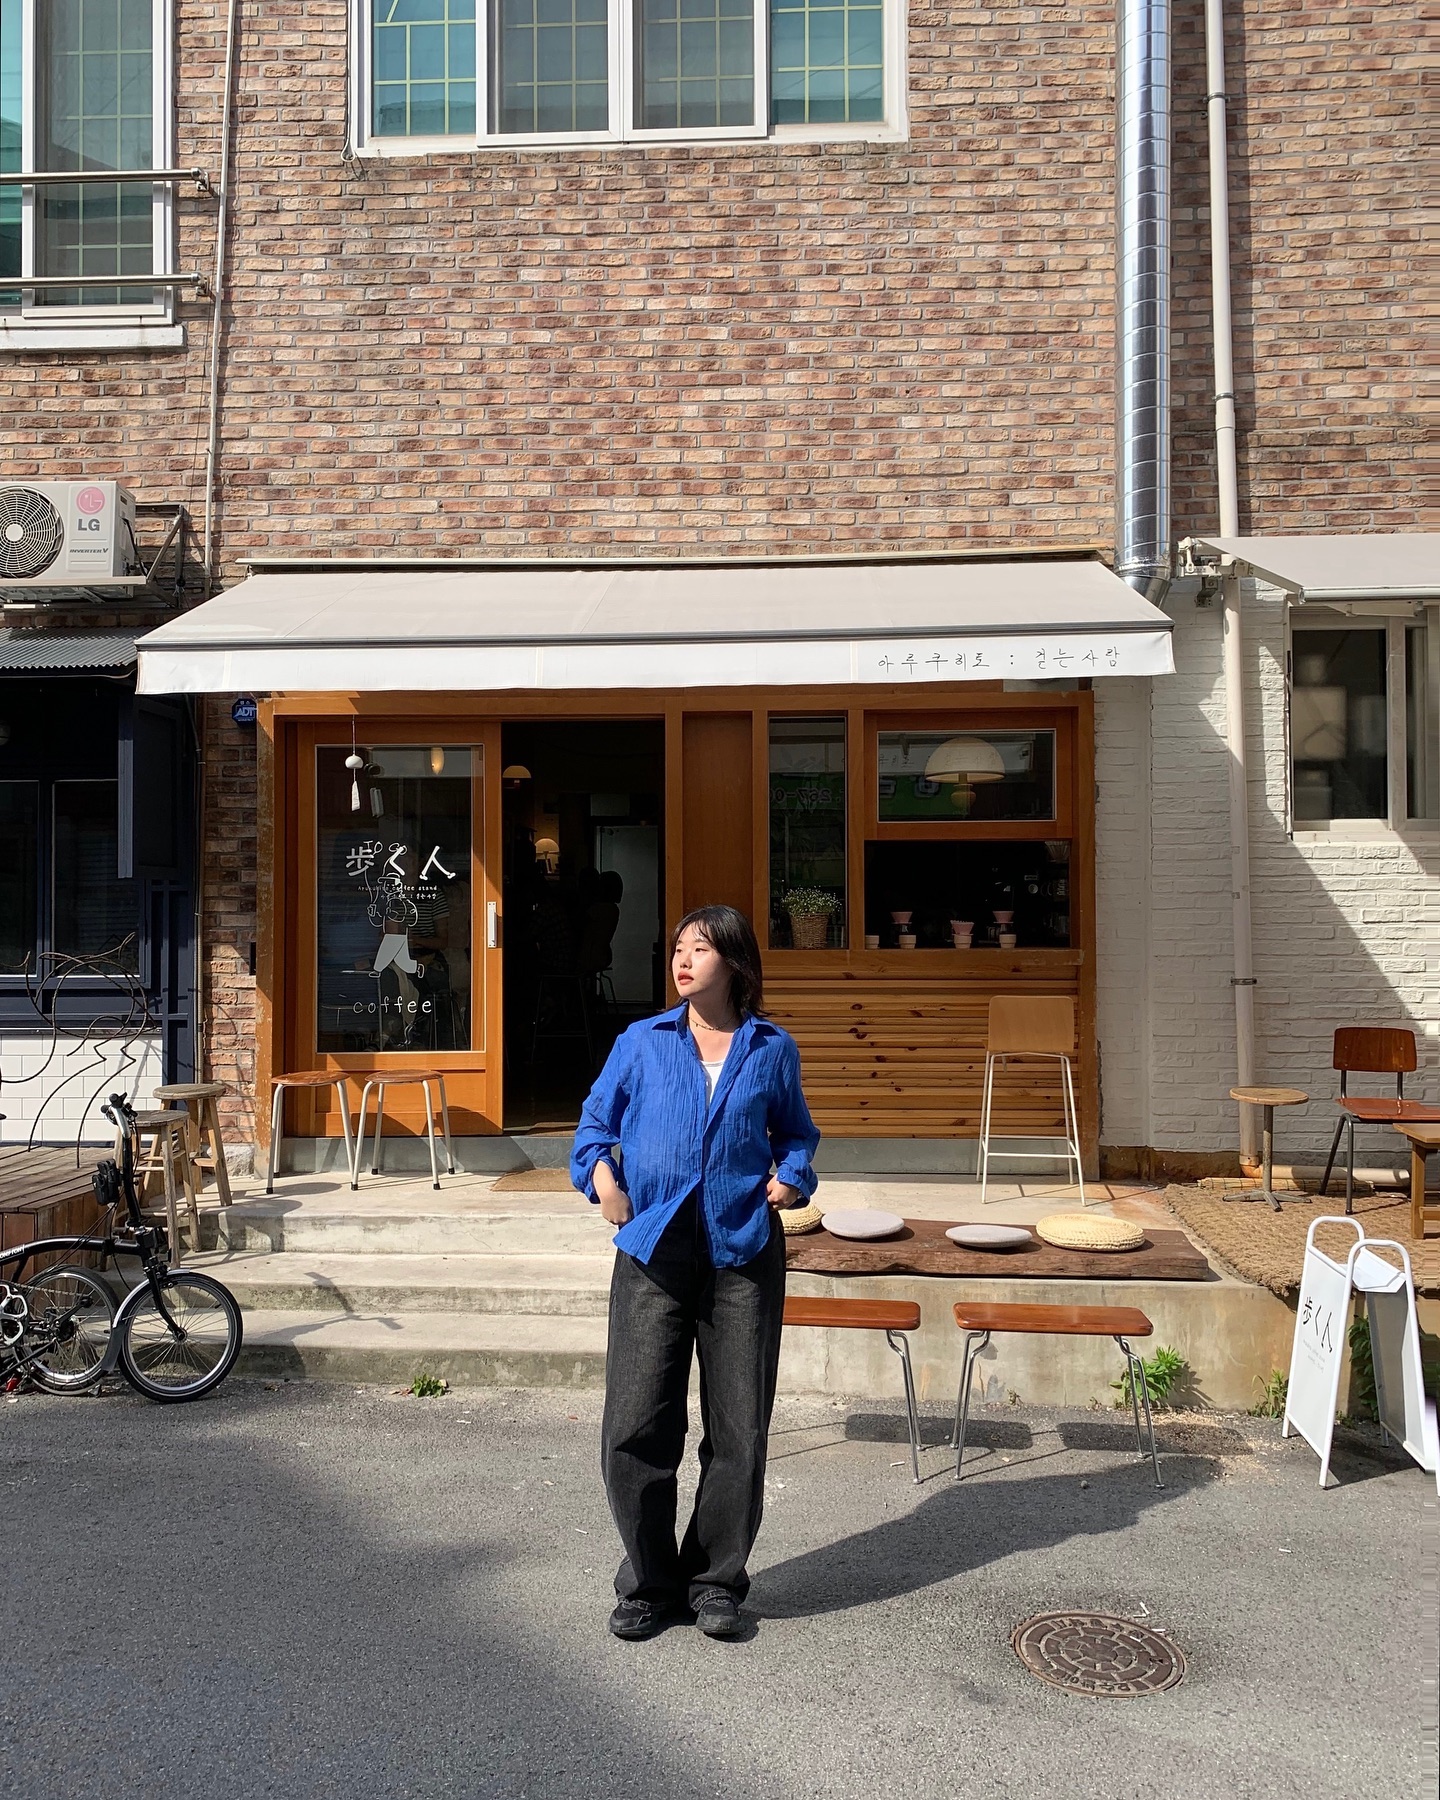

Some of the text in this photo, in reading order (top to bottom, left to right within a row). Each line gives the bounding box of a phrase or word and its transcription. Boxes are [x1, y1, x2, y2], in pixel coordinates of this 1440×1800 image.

[77, 518, 101, 532] LG
[878, 652, 990, 675] 아루쿠히토
[233, 707, 257, 718] ADT
[418, 884, 438, 892] stand
[353, 995, 432, 1015] coffee
